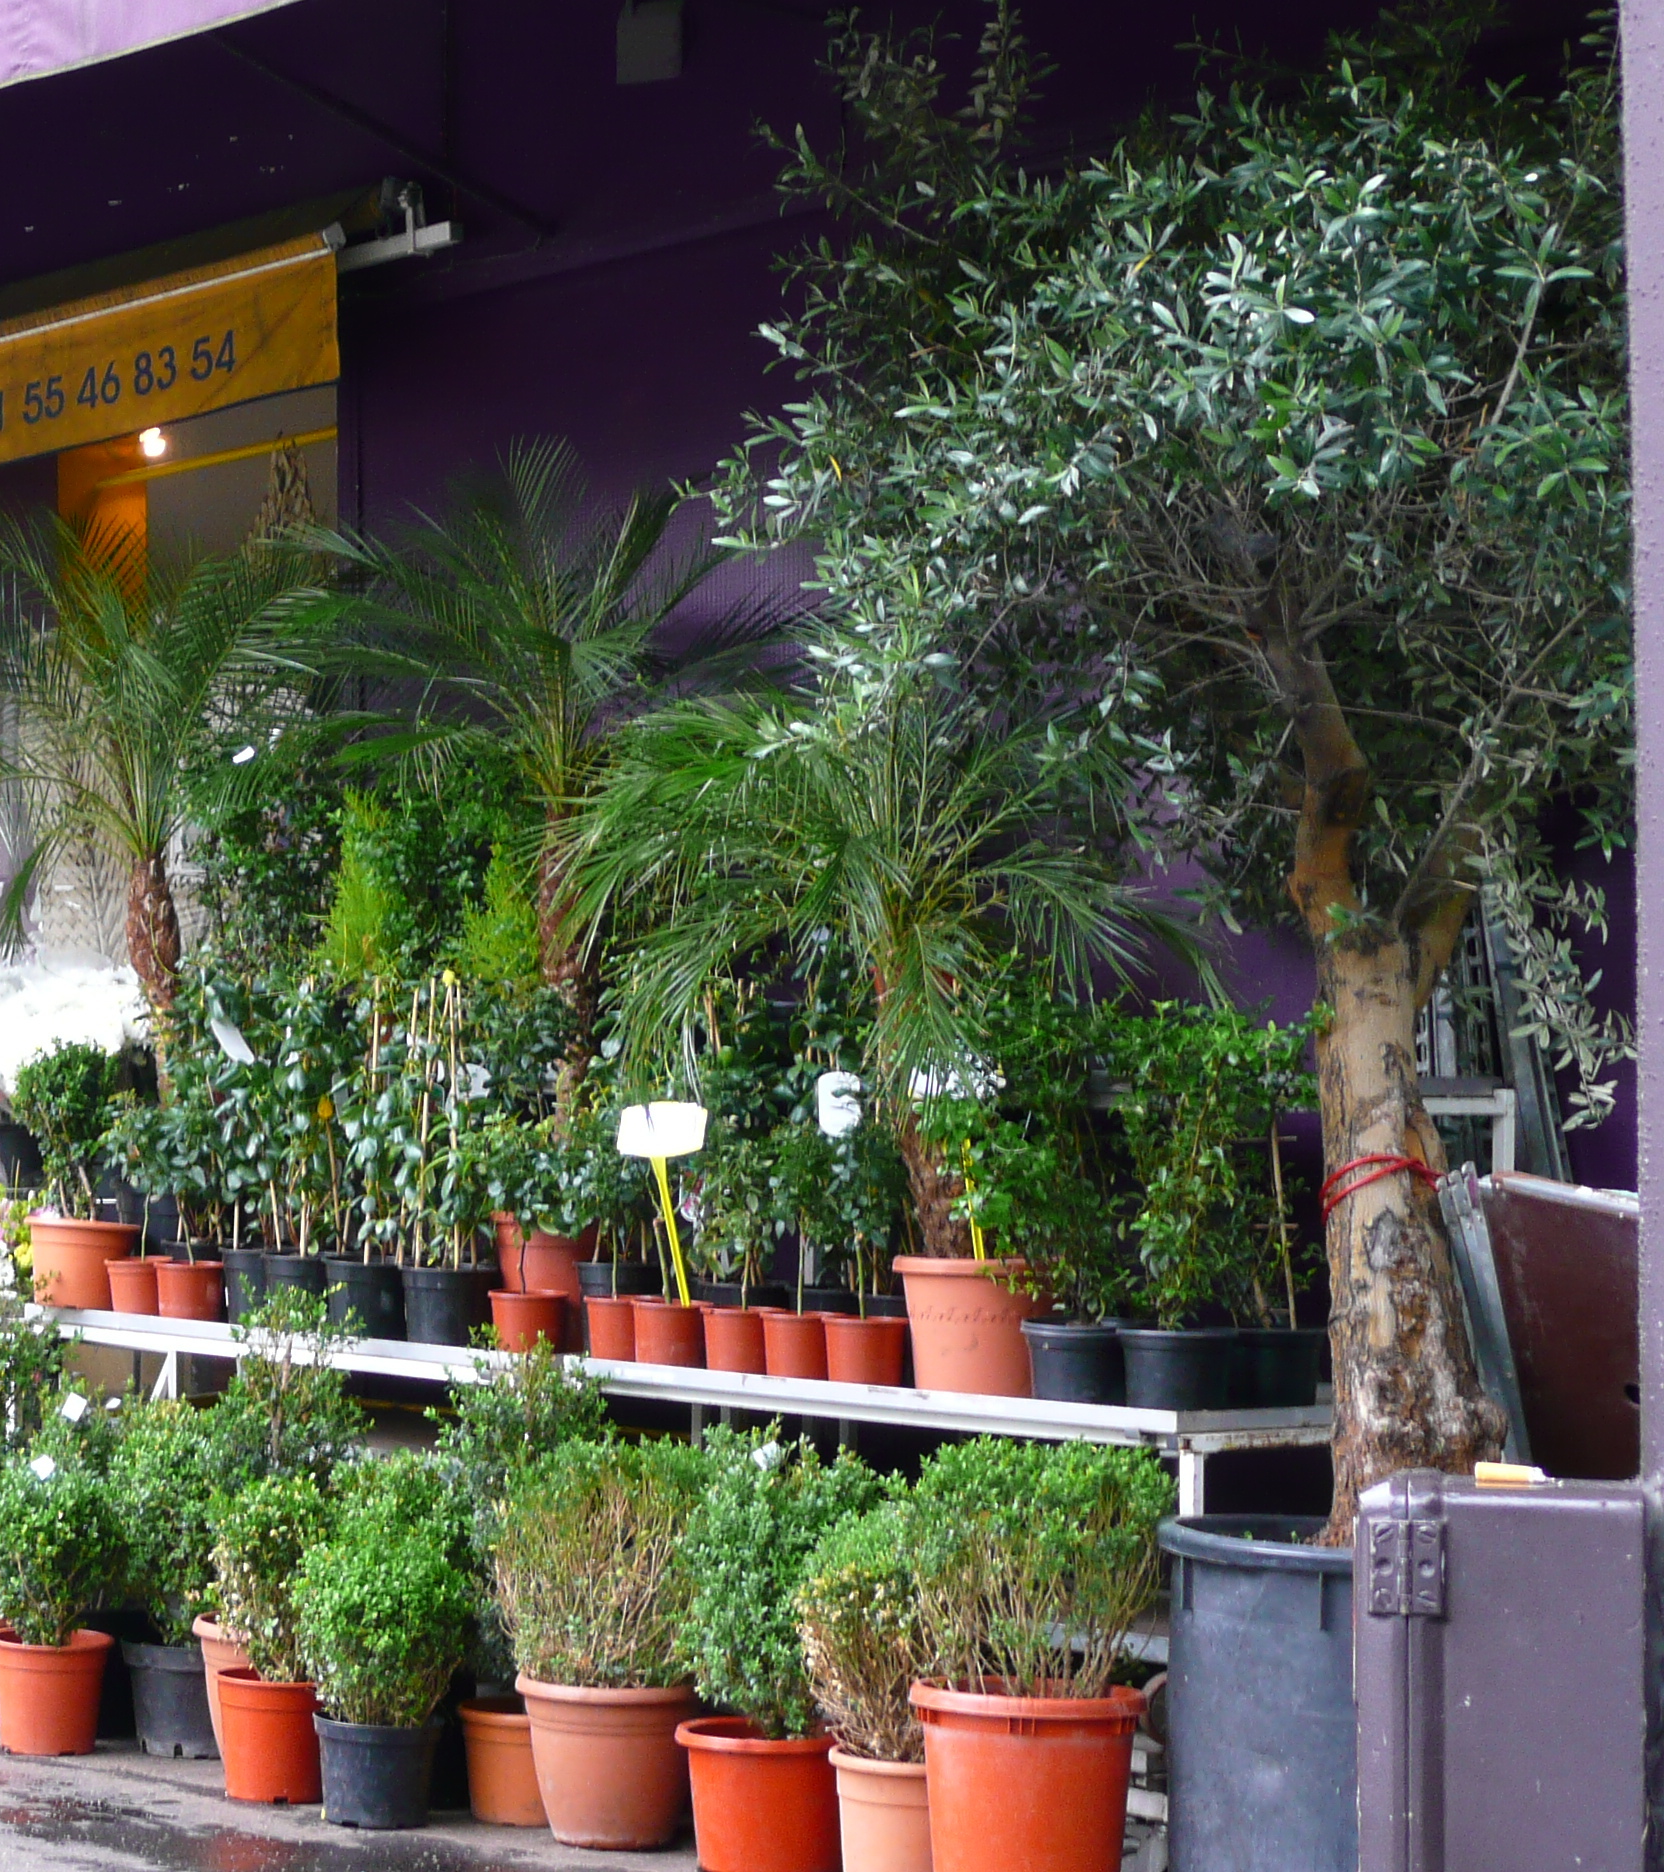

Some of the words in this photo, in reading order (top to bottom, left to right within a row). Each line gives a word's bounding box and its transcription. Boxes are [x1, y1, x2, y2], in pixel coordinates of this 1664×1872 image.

[23, 375, 65, 425] 55
[77, 361, 120, 408] 46
[134, 345, 177, 396] 83
[191, 329, 236, 381] 54
